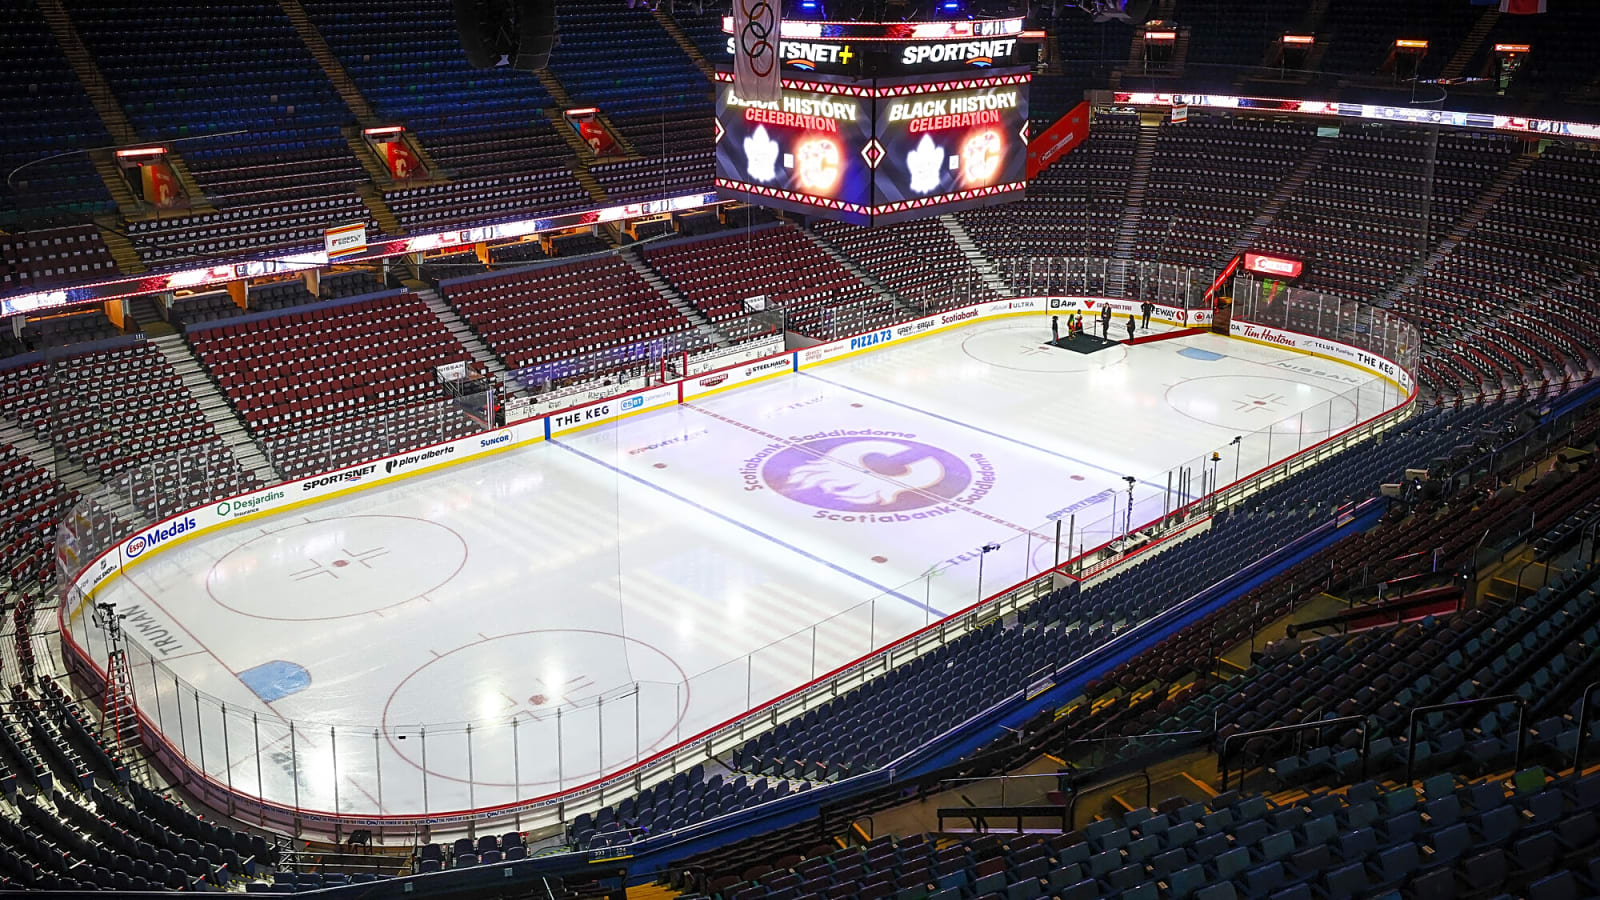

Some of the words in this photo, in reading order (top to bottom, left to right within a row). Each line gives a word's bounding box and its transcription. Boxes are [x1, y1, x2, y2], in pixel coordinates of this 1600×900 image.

[902, 39, 1016, 65] SPORTSNET
[783, 96, 857, 120] HISTORY
[888, 99, 948, 121] BLACK
[950, 91, 1018, 111] HISTORY
[745, 107, 838, 133] CELEBRATION
[909, 109, 1000, 133] CELEBRATION
[941, 308, 979, 325] Scotiabank
[1013, 301, 1034, 309] ULTRA
[850, 333, 879, 350] PIZZA
[880, 329, 892, 342] 73
[1243, 324, 1260, 339] Tim
[1260, 328, 1296, 347] Hortons
[1315, 342, 1335, 351] TELUS
[1357, 352, 1376, 367] THE
[1378, 360, 1394, 376] KEG
[556, 412, 581, 427] THE
[586, 405, 610, 420] KEG
[789, 428, 917, 443] Saddledome
[399, 453, 420, 469] play
[420, 445, 455, 461] alberta
[741, 442, 786, 492] Scotiabank
[302, 464, 377, 491] SPORTSNET
[957, 452, 996, 505] Saddledome
[233, 491, 285, 510] Desjardins
[812, 504, 957, 524] Scotiabank
[147, 517, 196, 547] Medals
[119, 604, 183, 656] TRUMAN
